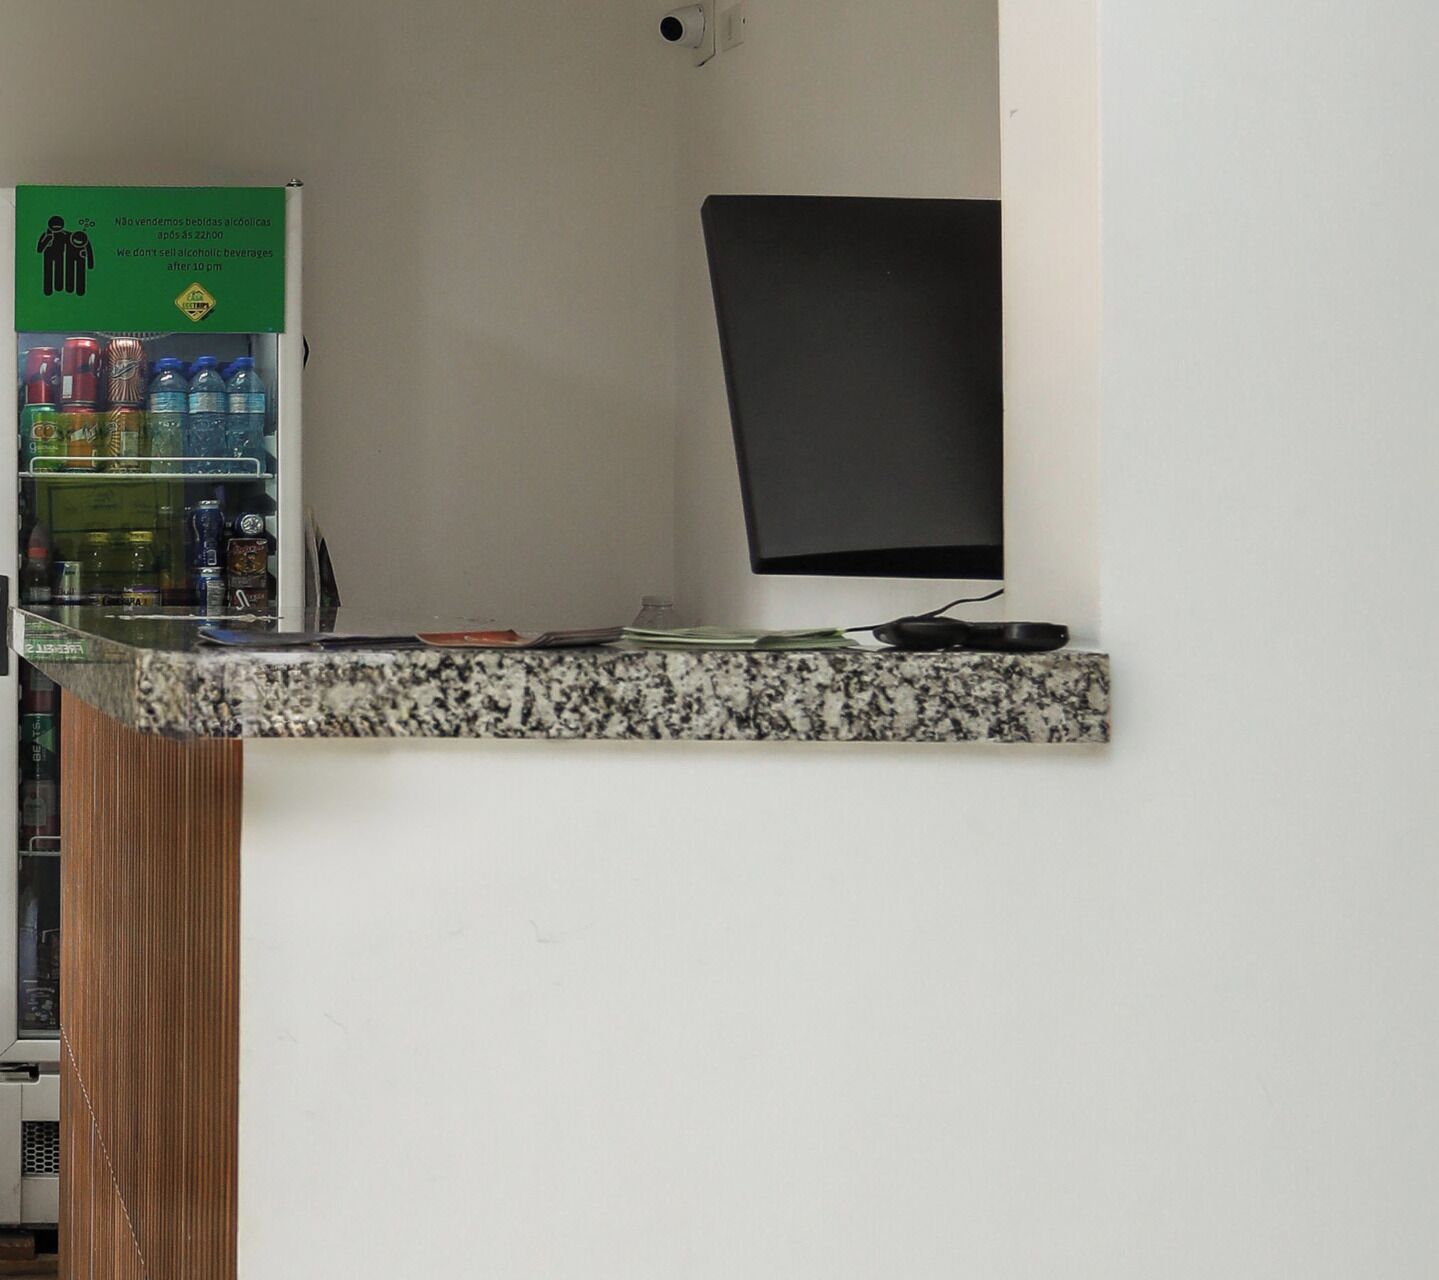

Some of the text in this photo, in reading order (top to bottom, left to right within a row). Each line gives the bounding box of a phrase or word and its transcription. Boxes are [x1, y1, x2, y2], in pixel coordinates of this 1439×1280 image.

[135, 218, 183, 226] vendemos
[185, 217, 222, 226] bebidas
[117, 248, 273, 258] We don't sell alcoholic beverages
[167, 262, 222, 272] after 10 pm
[32, 722, 42, 761] BEATS
